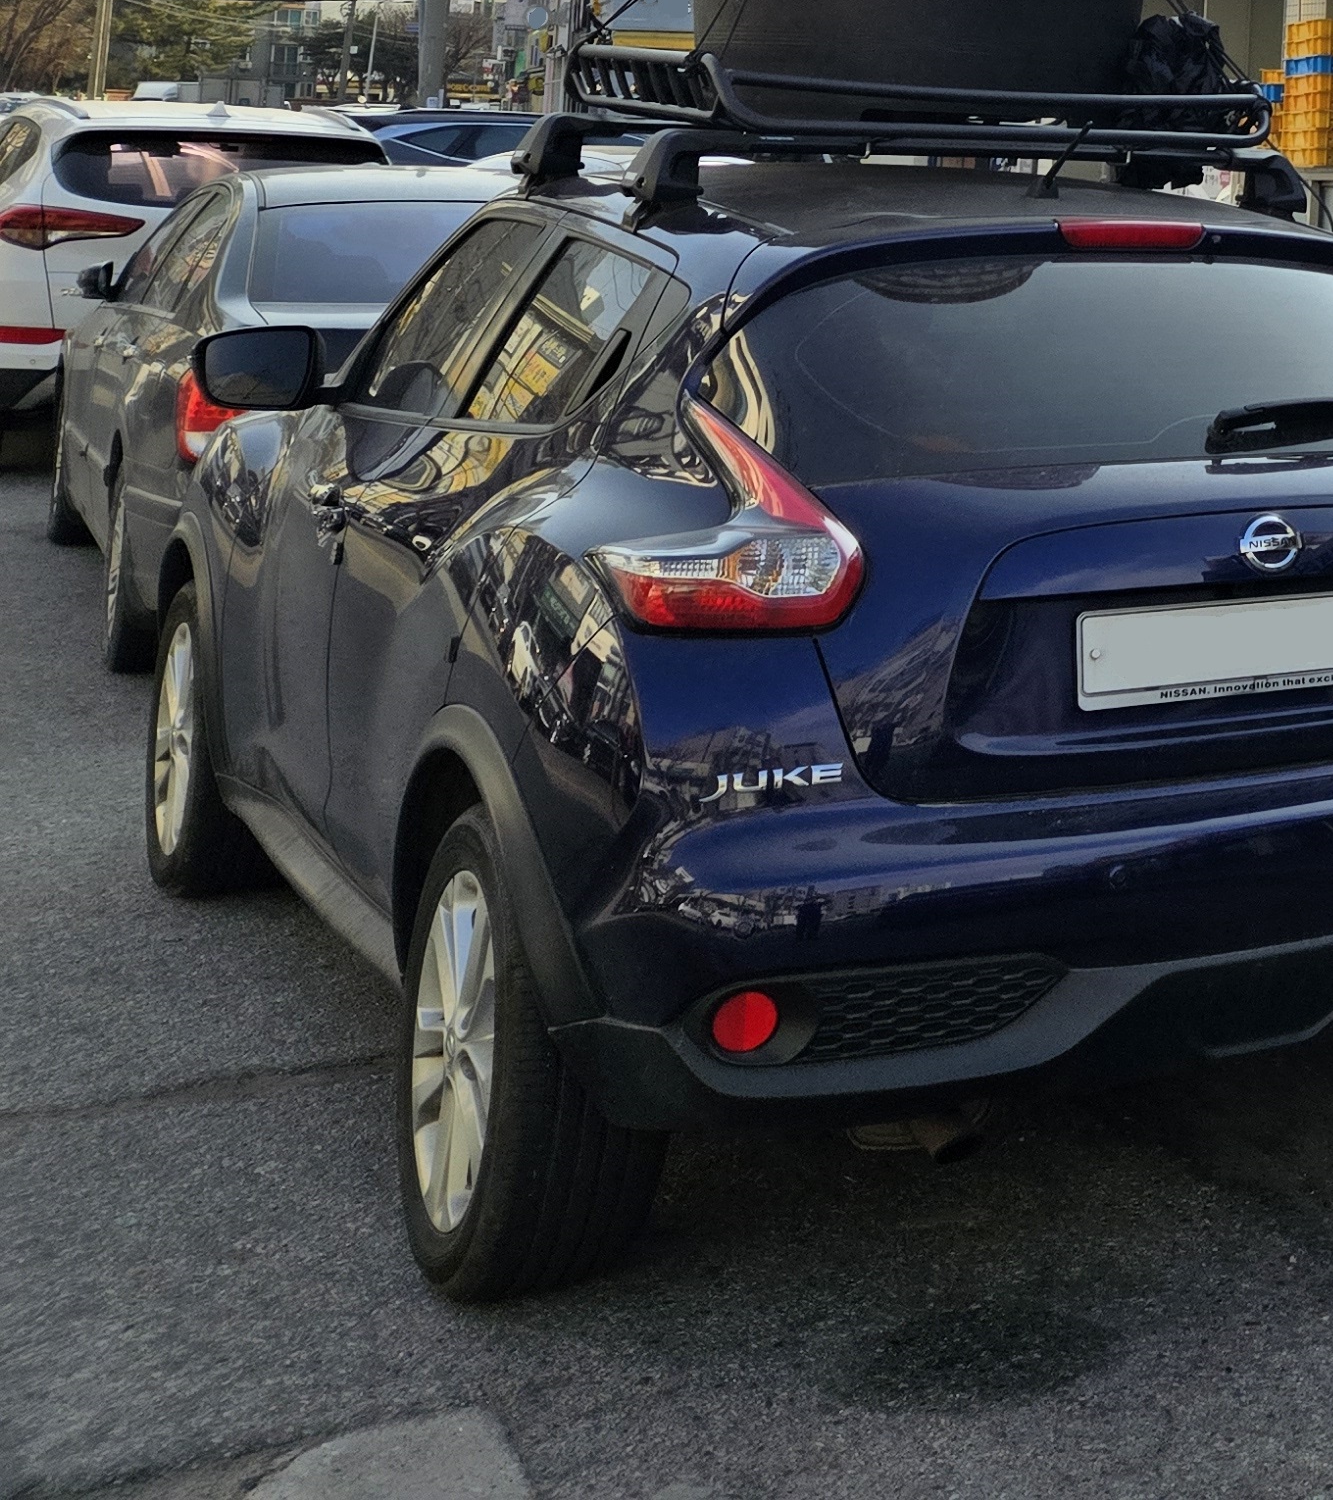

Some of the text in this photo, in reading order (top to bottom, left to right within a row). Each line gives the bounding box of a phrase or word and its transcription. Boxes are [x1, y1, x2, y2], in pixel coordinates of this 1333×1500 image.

[1248, 536, 1299, 549] NISSAN
[1159, 686, 1211, 699] NISSAN.
[1213, 677, 1280, 694] Innovation
[1282, 675, 1306, 688] that
[698, 762, 844, 803] JUKE
